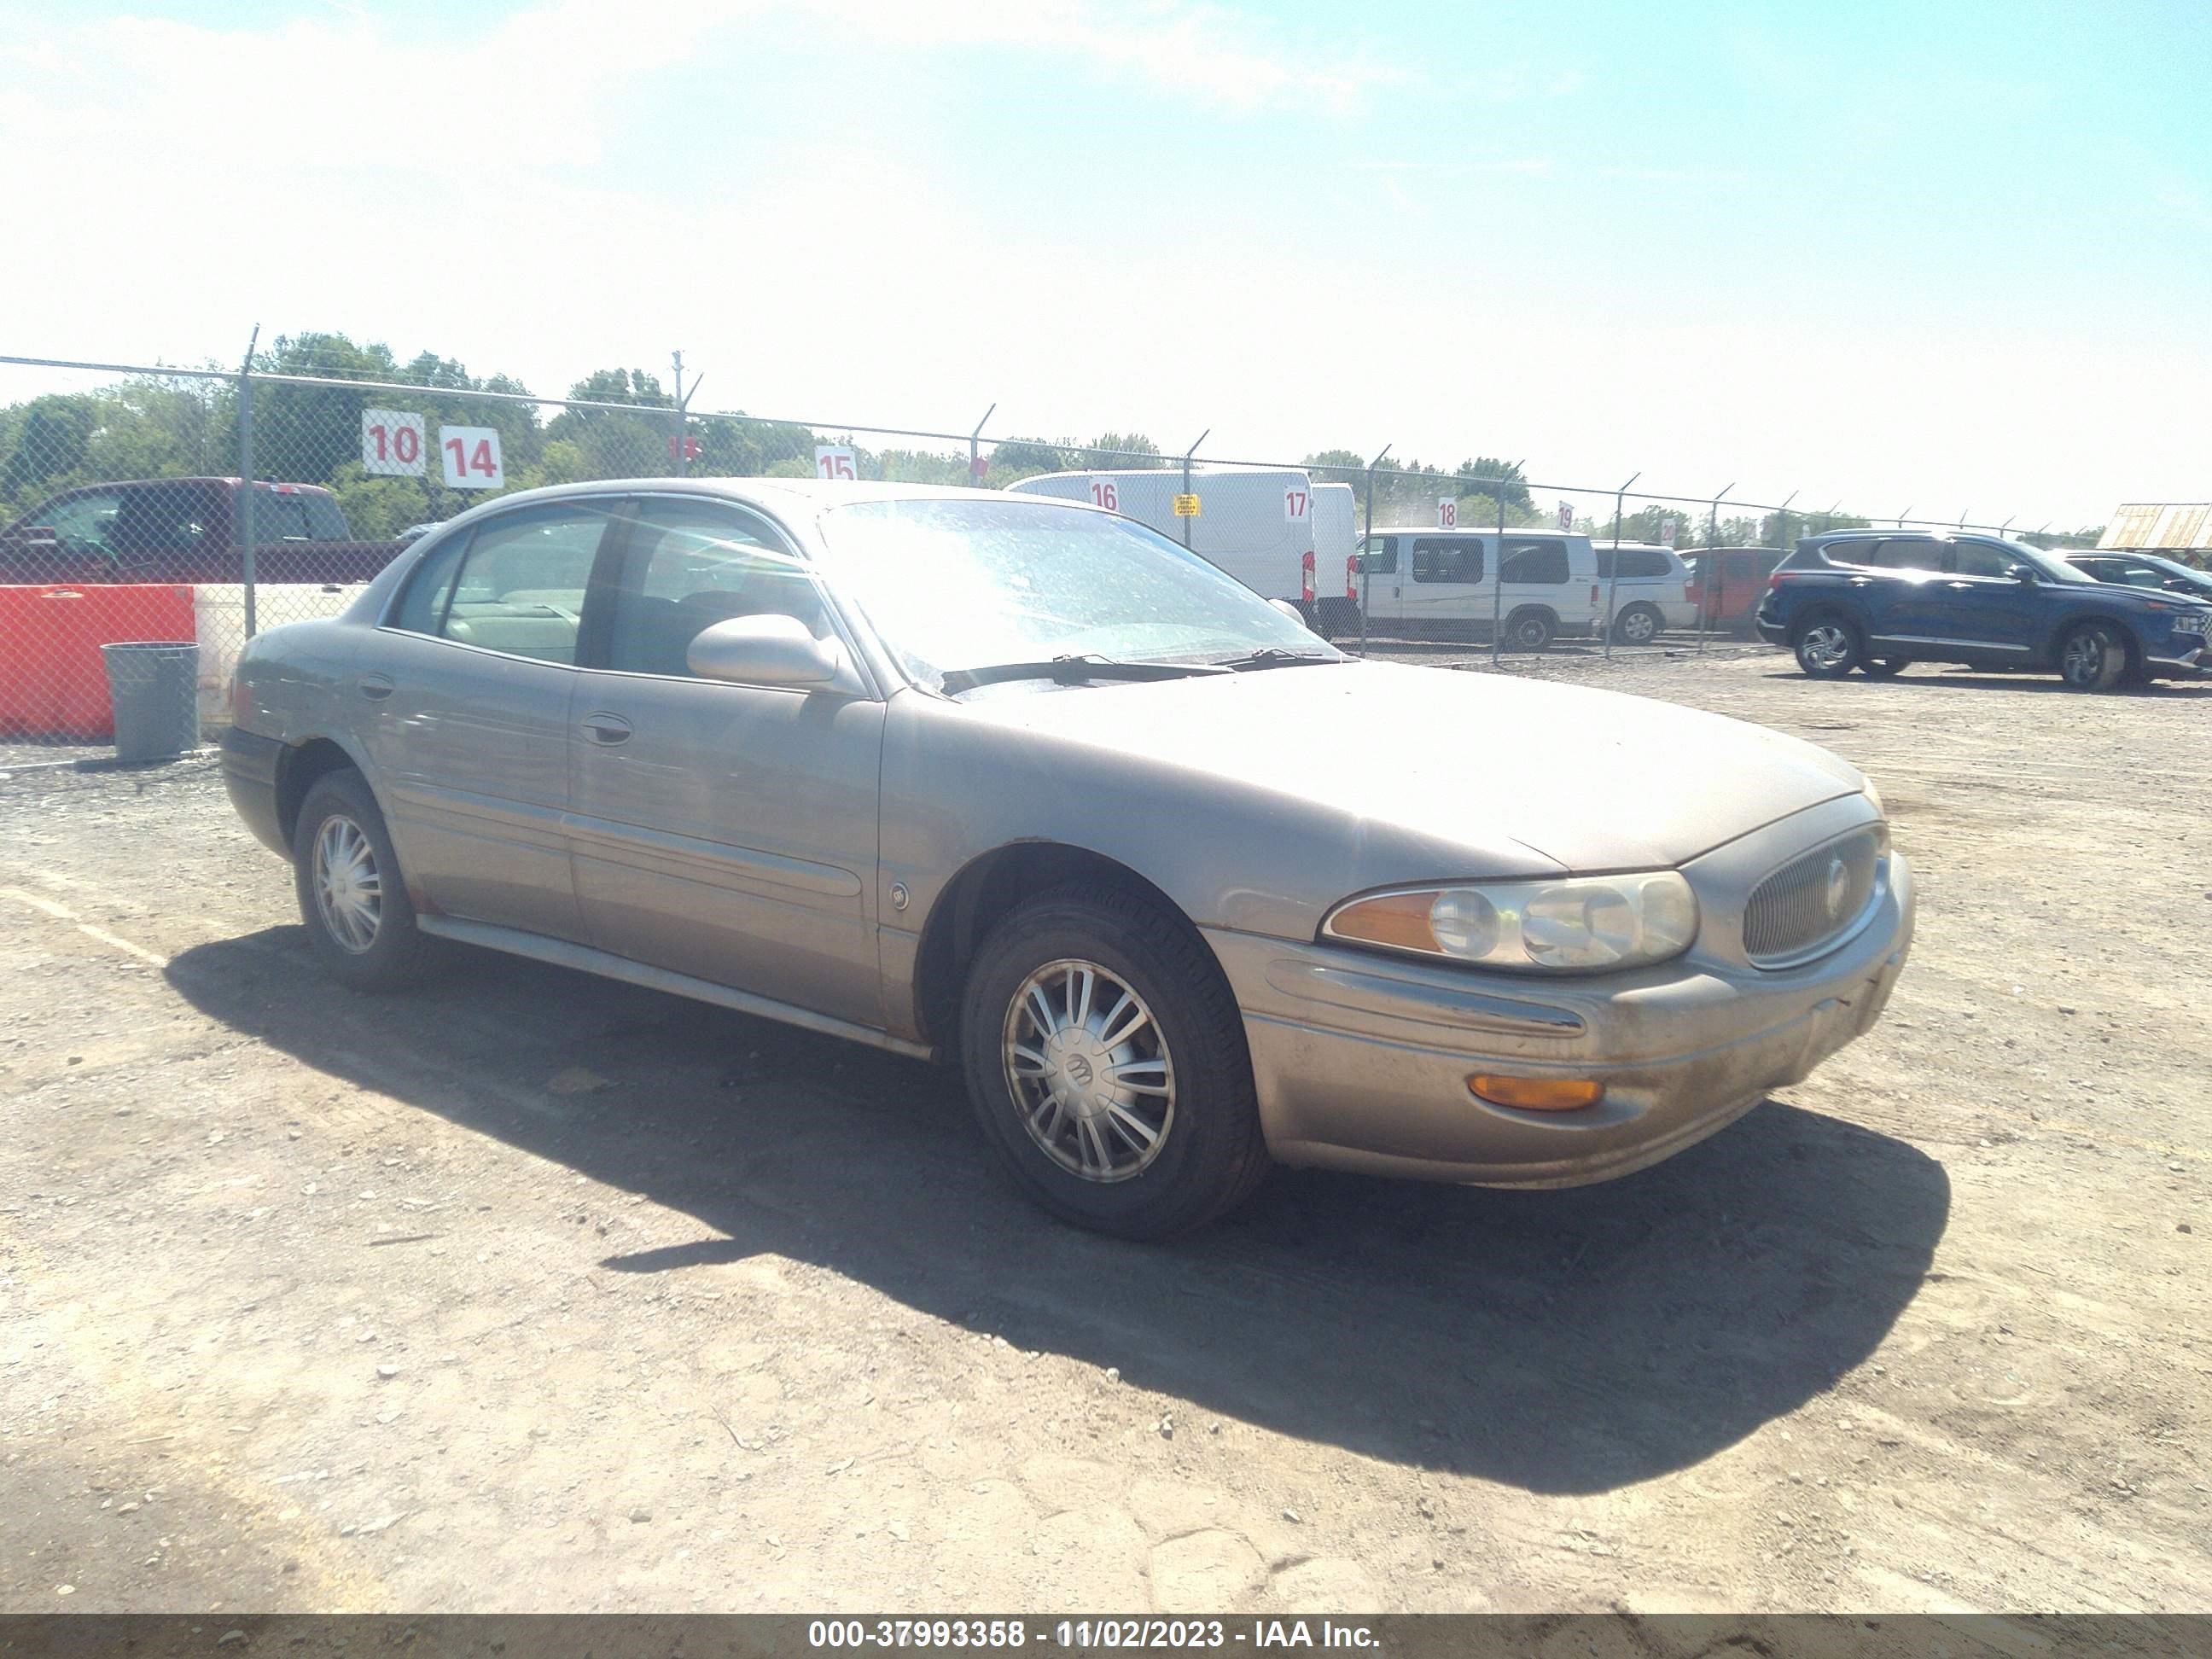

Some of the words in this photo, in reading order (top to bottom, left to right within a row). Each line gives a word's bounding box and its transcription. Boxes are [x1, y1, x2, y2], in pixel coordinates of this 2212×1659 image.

[369, 424, 418, 464] 10
[445, 438, 497, 478] 14
[819, 455, 853, 480] 15
[1091, 483, 1116, 511] 16
[1286, 492, 1306, 516] 17
[1440, 504, 1455, 526] 18
[1559, 507, 1572, 529] 19
